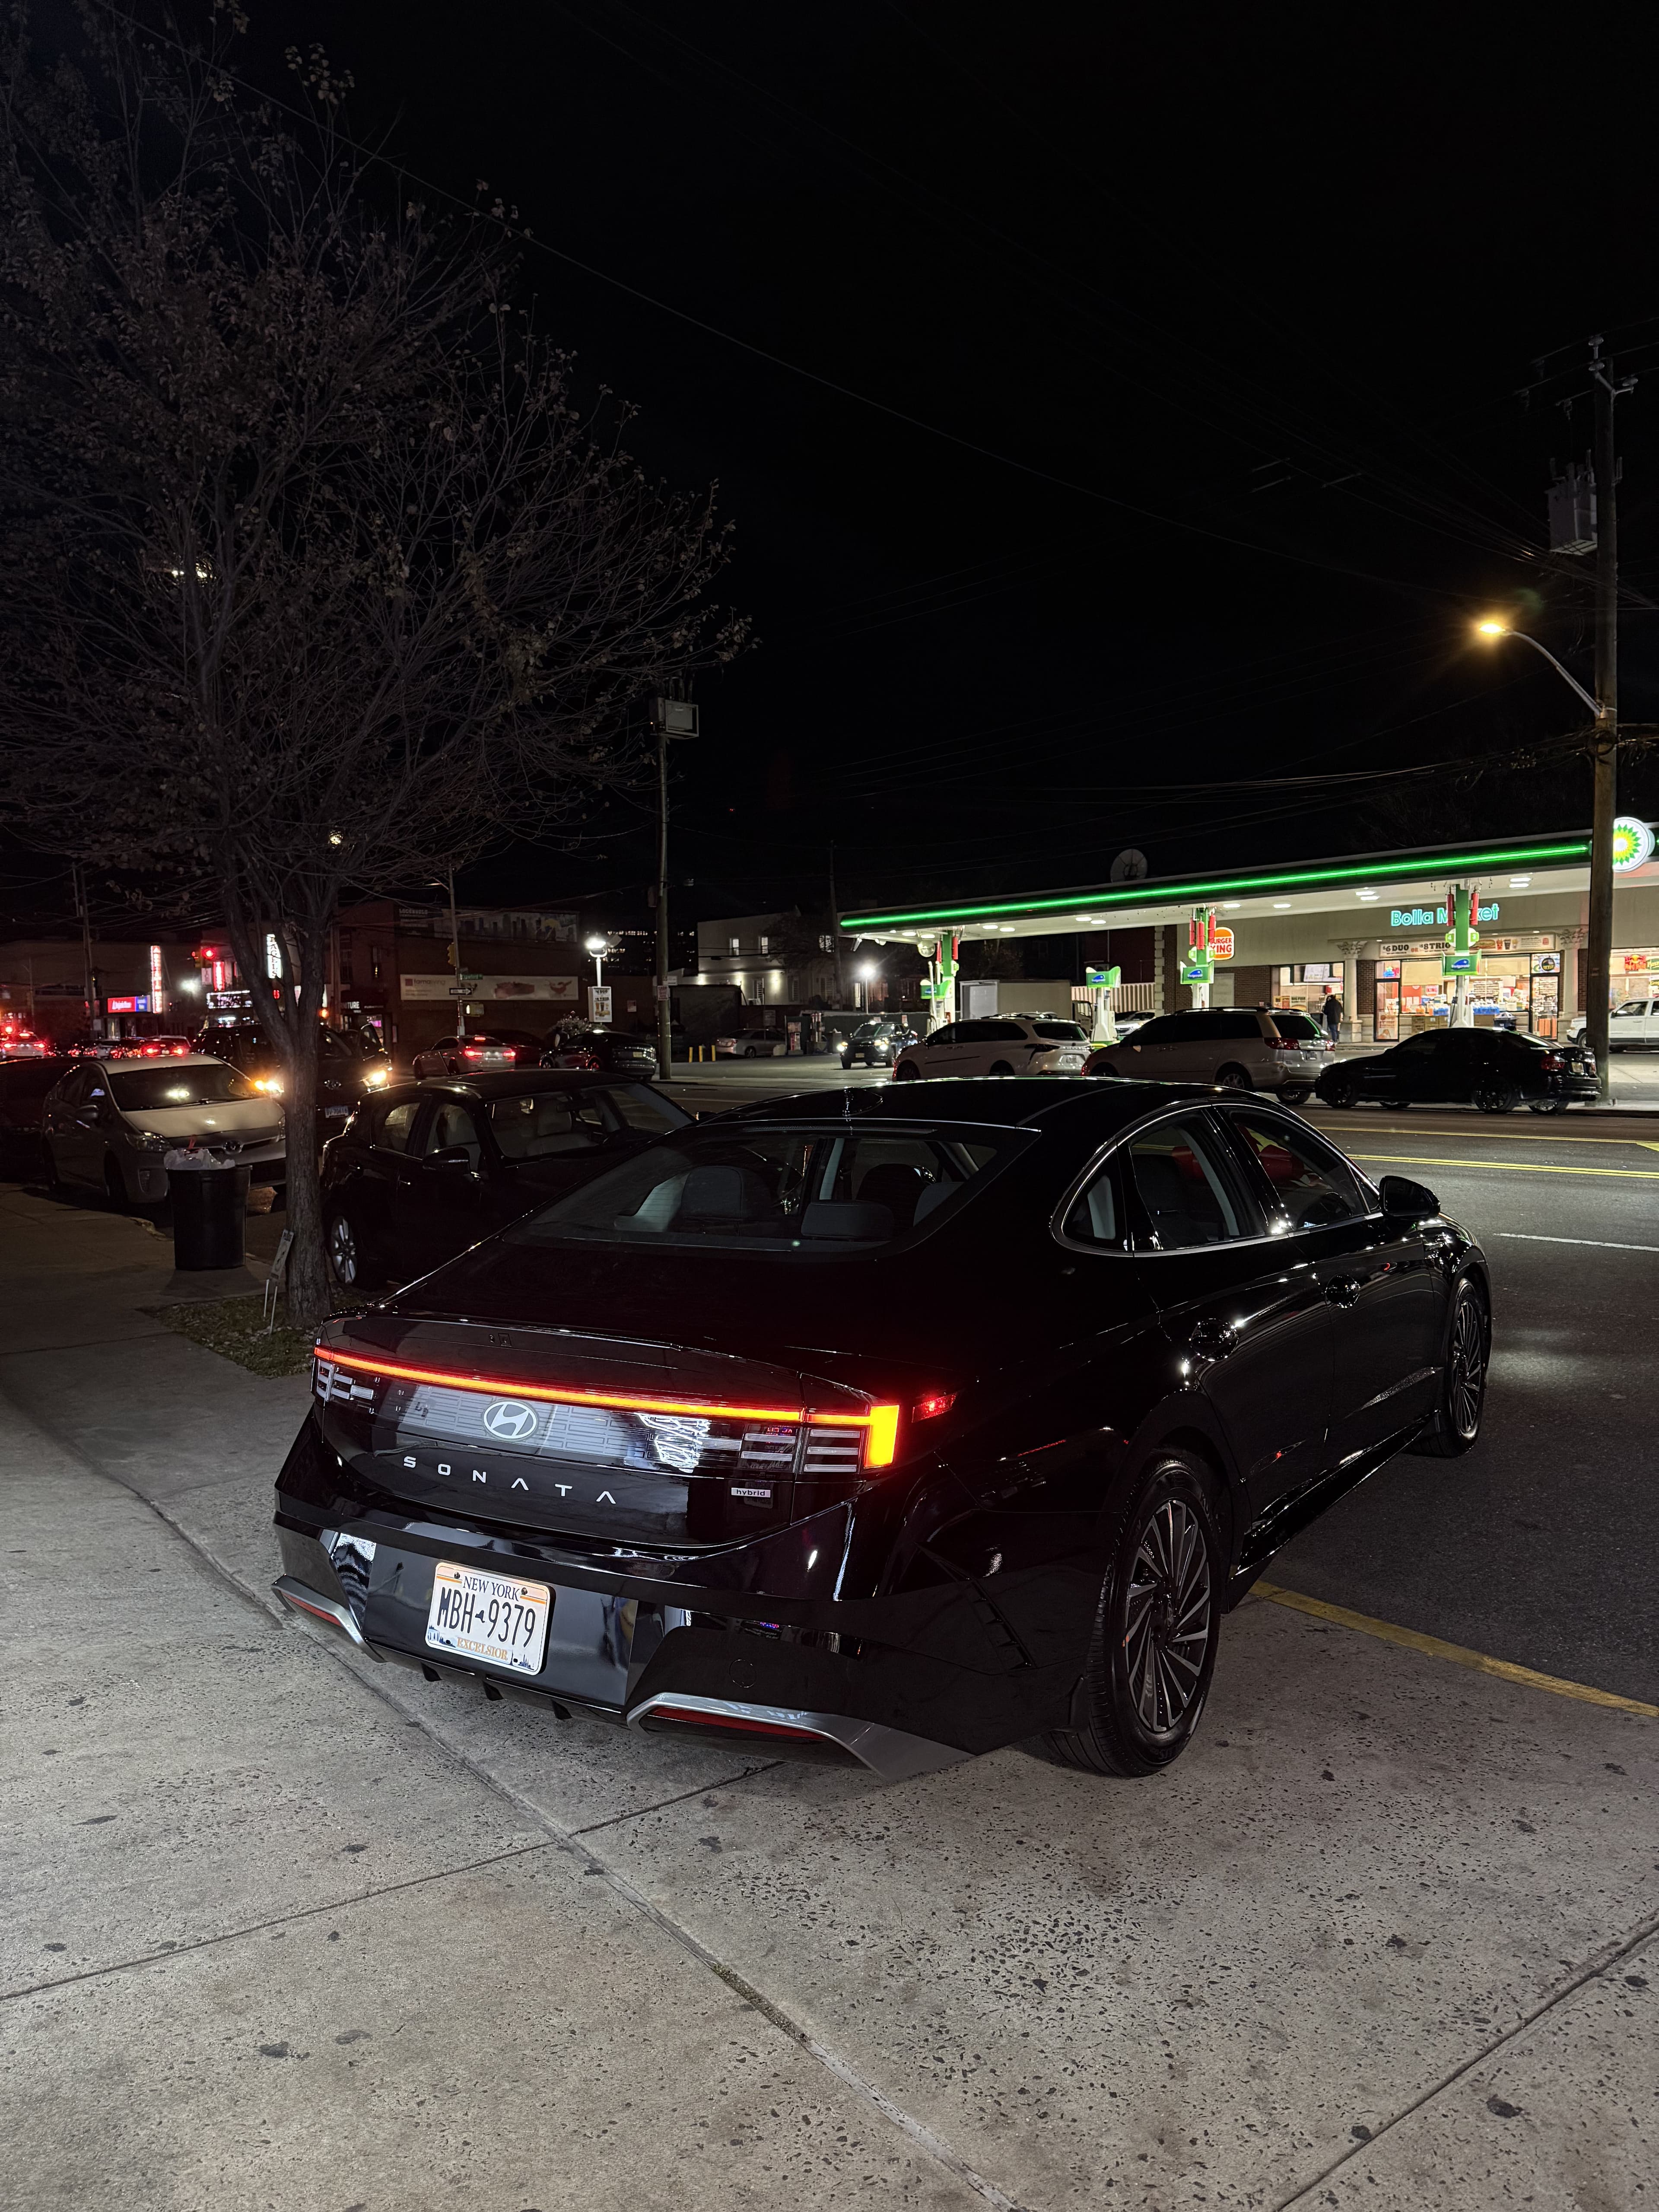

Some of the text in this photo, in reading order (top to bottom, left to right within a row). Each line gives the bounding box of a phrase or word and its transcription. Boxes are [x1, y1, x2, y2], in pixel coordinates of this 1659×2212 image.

[1391, 903, 1500, 926] Bolla Mket
[404, 1456, 616, 1504] SONATA
[463, 1576, 519, 1601] NEW YORK
[457, 1637, 508, 1661] EXCELSIOR
